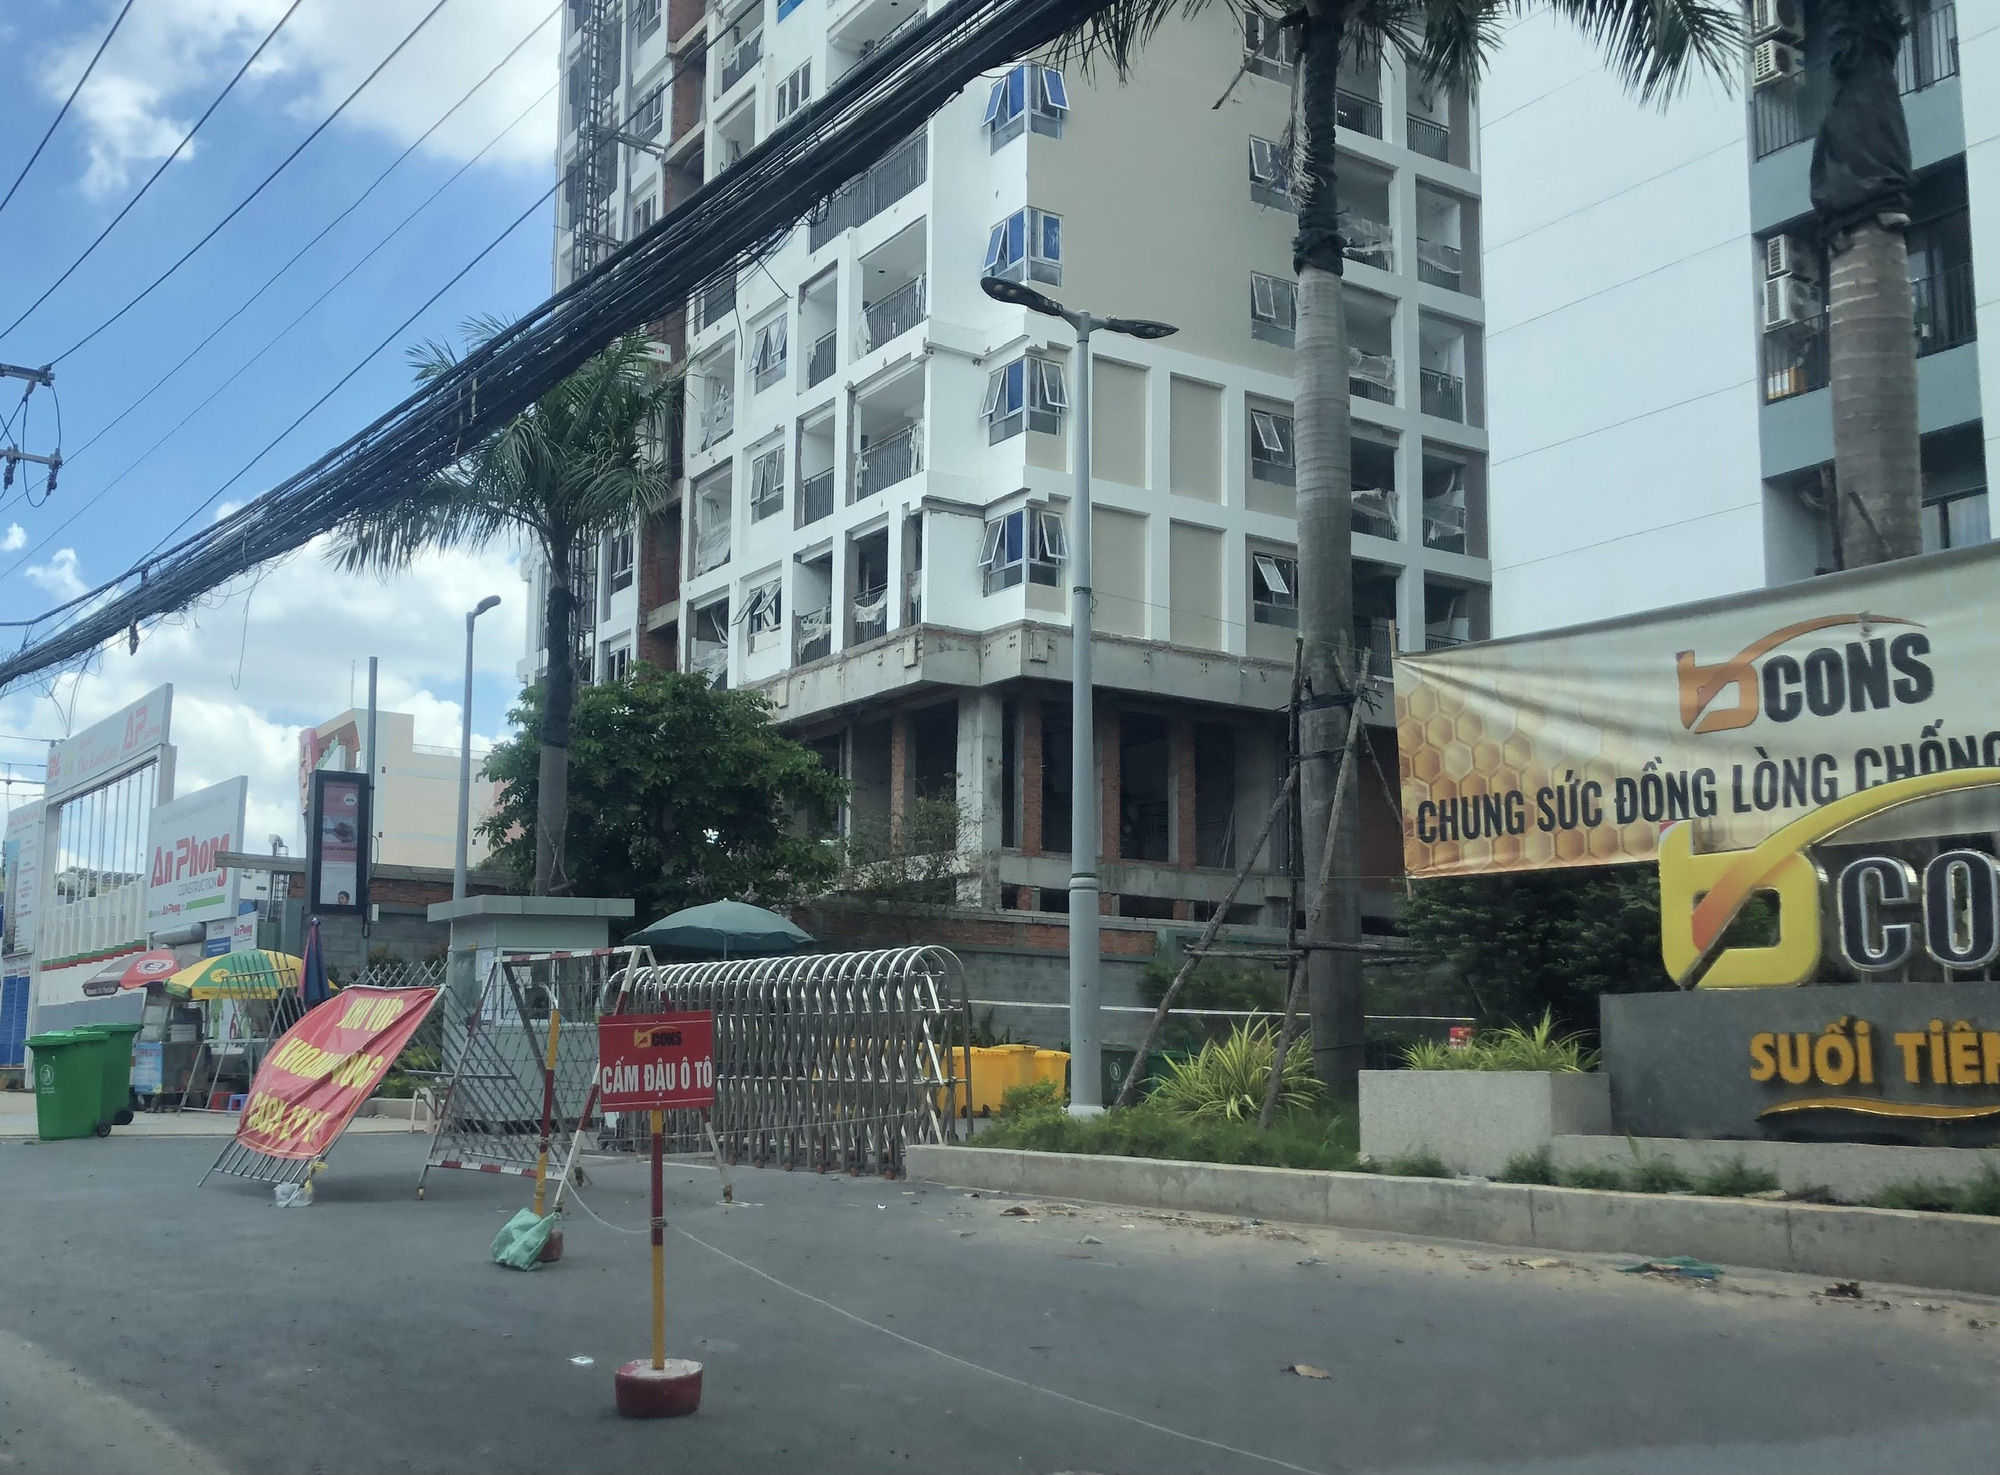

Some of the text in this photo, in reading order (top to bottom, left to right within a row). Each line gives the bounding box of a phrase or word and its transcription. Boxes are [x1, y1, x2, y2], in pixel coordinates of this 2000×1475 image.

[1417, 790, 1525, 844] CHUNG
[1536, 769, 1603, 832] SỨC
[1614, 756, 1718, 824] ĐỒNG
[1732, 746, 1838, 813] LÒNG
[150, 832, 230, 889] An Phong
[602, 1055, 713, 1097] CẤM ĐẬU Ô TÔ
